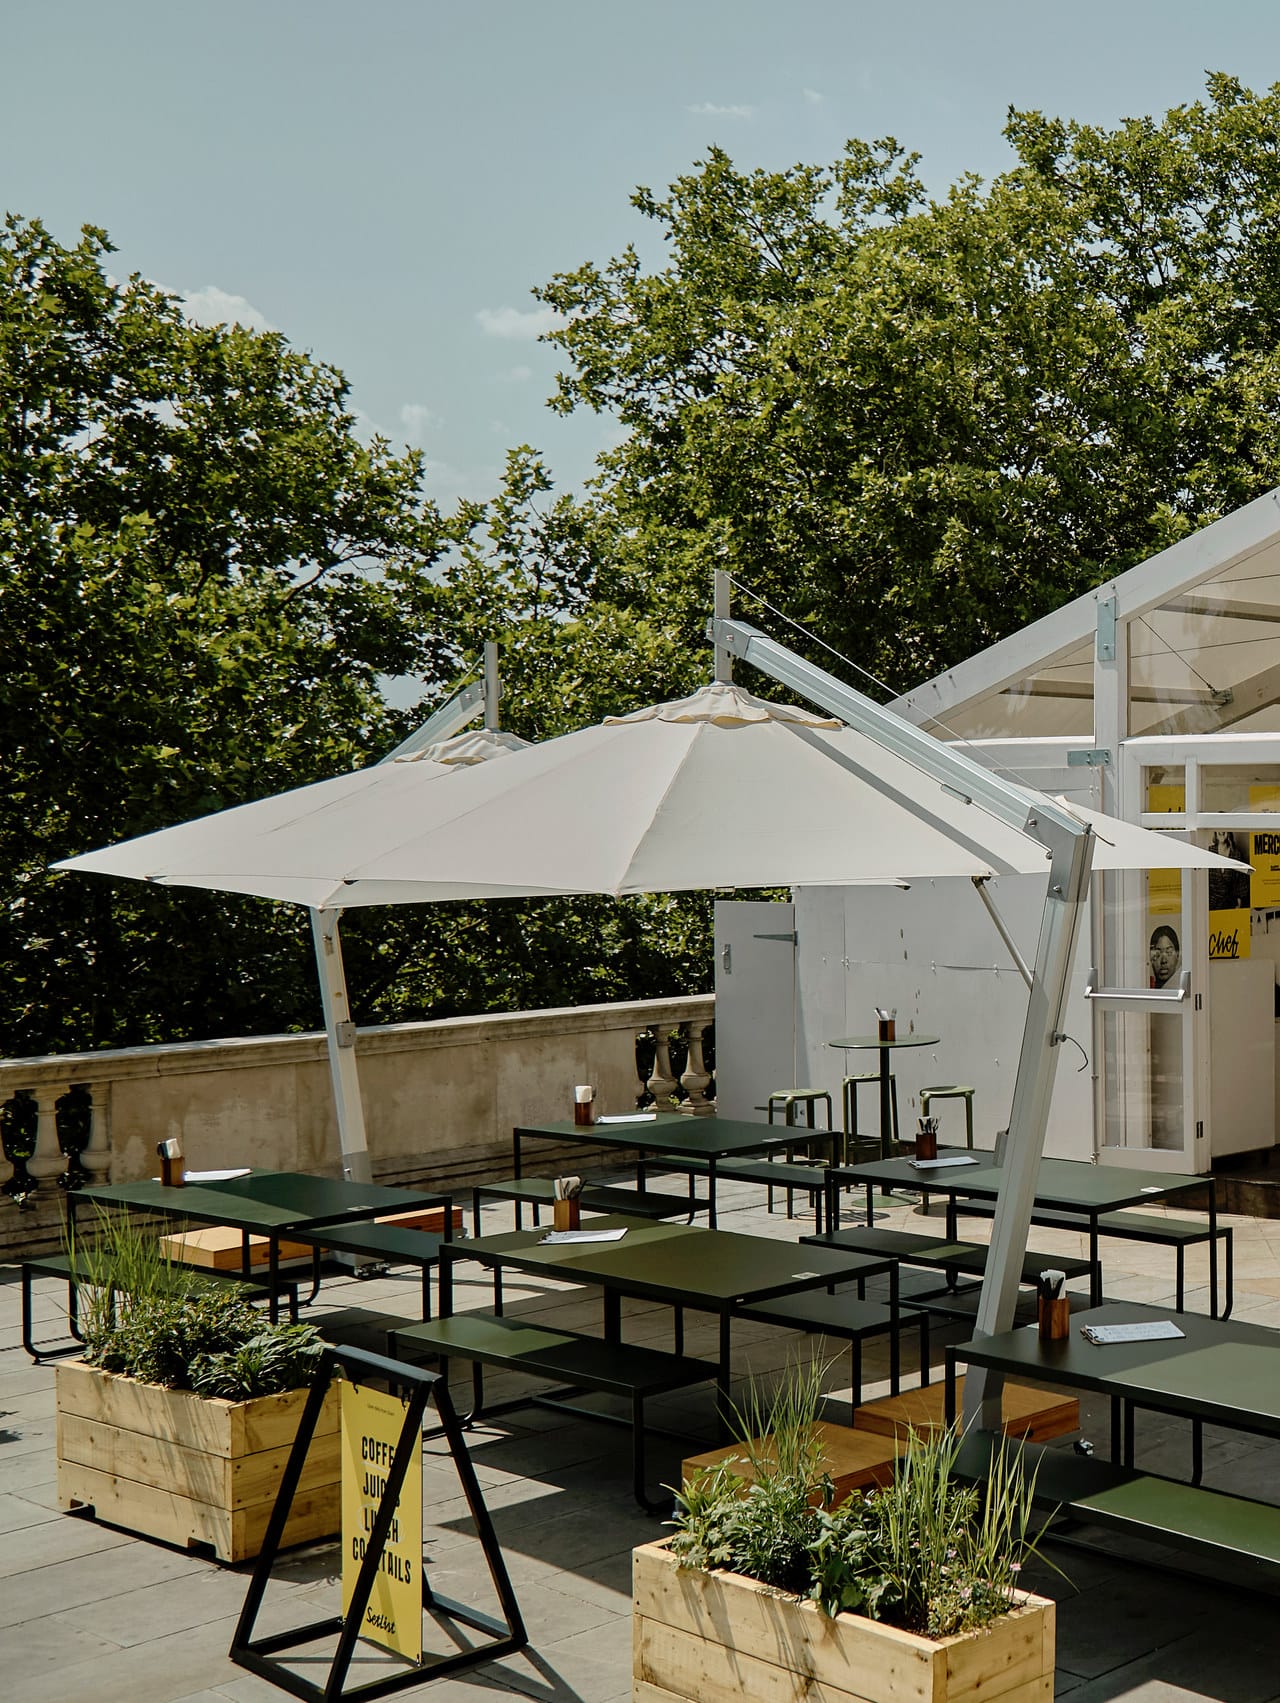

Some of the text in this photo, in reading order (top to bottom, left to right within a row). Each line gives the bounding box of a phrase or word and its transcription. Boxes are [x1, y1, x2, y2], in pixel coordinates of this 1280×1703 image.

[1208, 929, 1239, 957] Chef
[362, 1436, 397, 1468] COFFE
[352, 1537, 411, 1584] COTAILS
